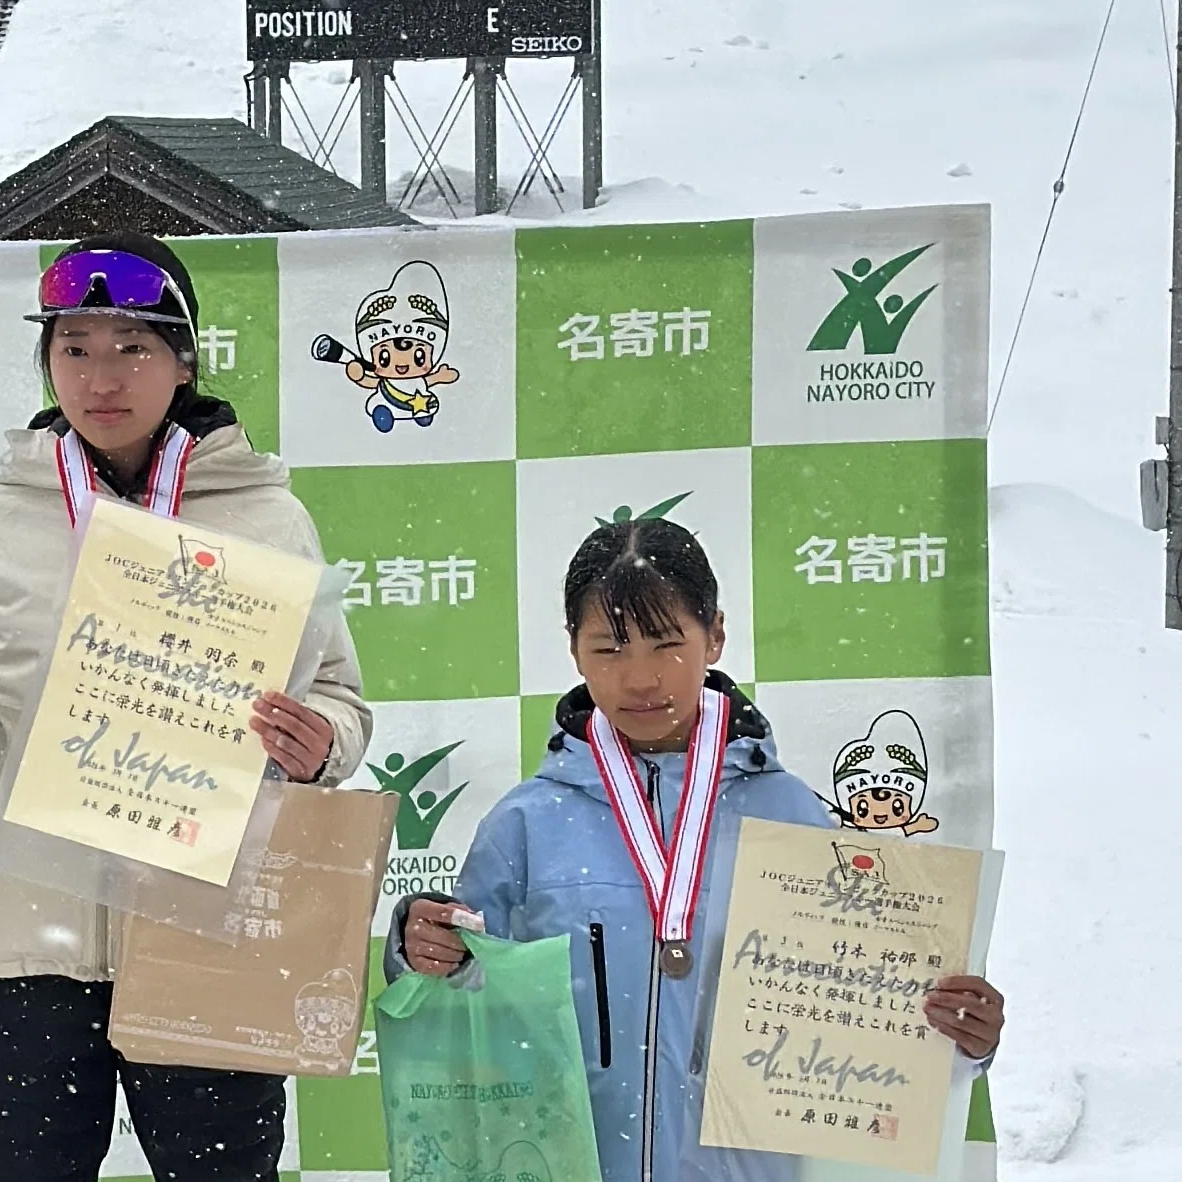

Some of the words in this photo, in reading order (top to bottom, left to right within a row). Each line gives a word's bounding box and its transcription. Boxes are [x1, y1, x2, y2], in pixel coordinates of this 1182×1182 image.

[255, 11, 352, 37] POSITION
[487, 8, 499, 33] E
[511, 36, 582, 53] SEIKO
[368, 324, 436, 342] NAYORO
[557, 307, 711, 361] 名寄市
[820, 361, 924, 381] HOKKAIDO
[807, 382, 892, 402] NAYORO
[896, 380, 936, 401] CITY
[795, 533, 947, 584] 名寄市
[334, 556, 477, 607] 名寄市
[80, 660, 235, 716] いかんなく発揮しました
[69, 704, 110, 725] します
[114, 731, 218, 791] Japan
[846, 774, 915, 793] NAYORO
[386, 855, 456, 874] KKAIDO
[382, 878, 423, 896] ORO
[429, 876, 459, 893] CIT
[748, 976, 915, 1014] いかんなく発揮しました
[744, 1019, 787, 1037] します
[797, 1037, 910, 1093] Japan
